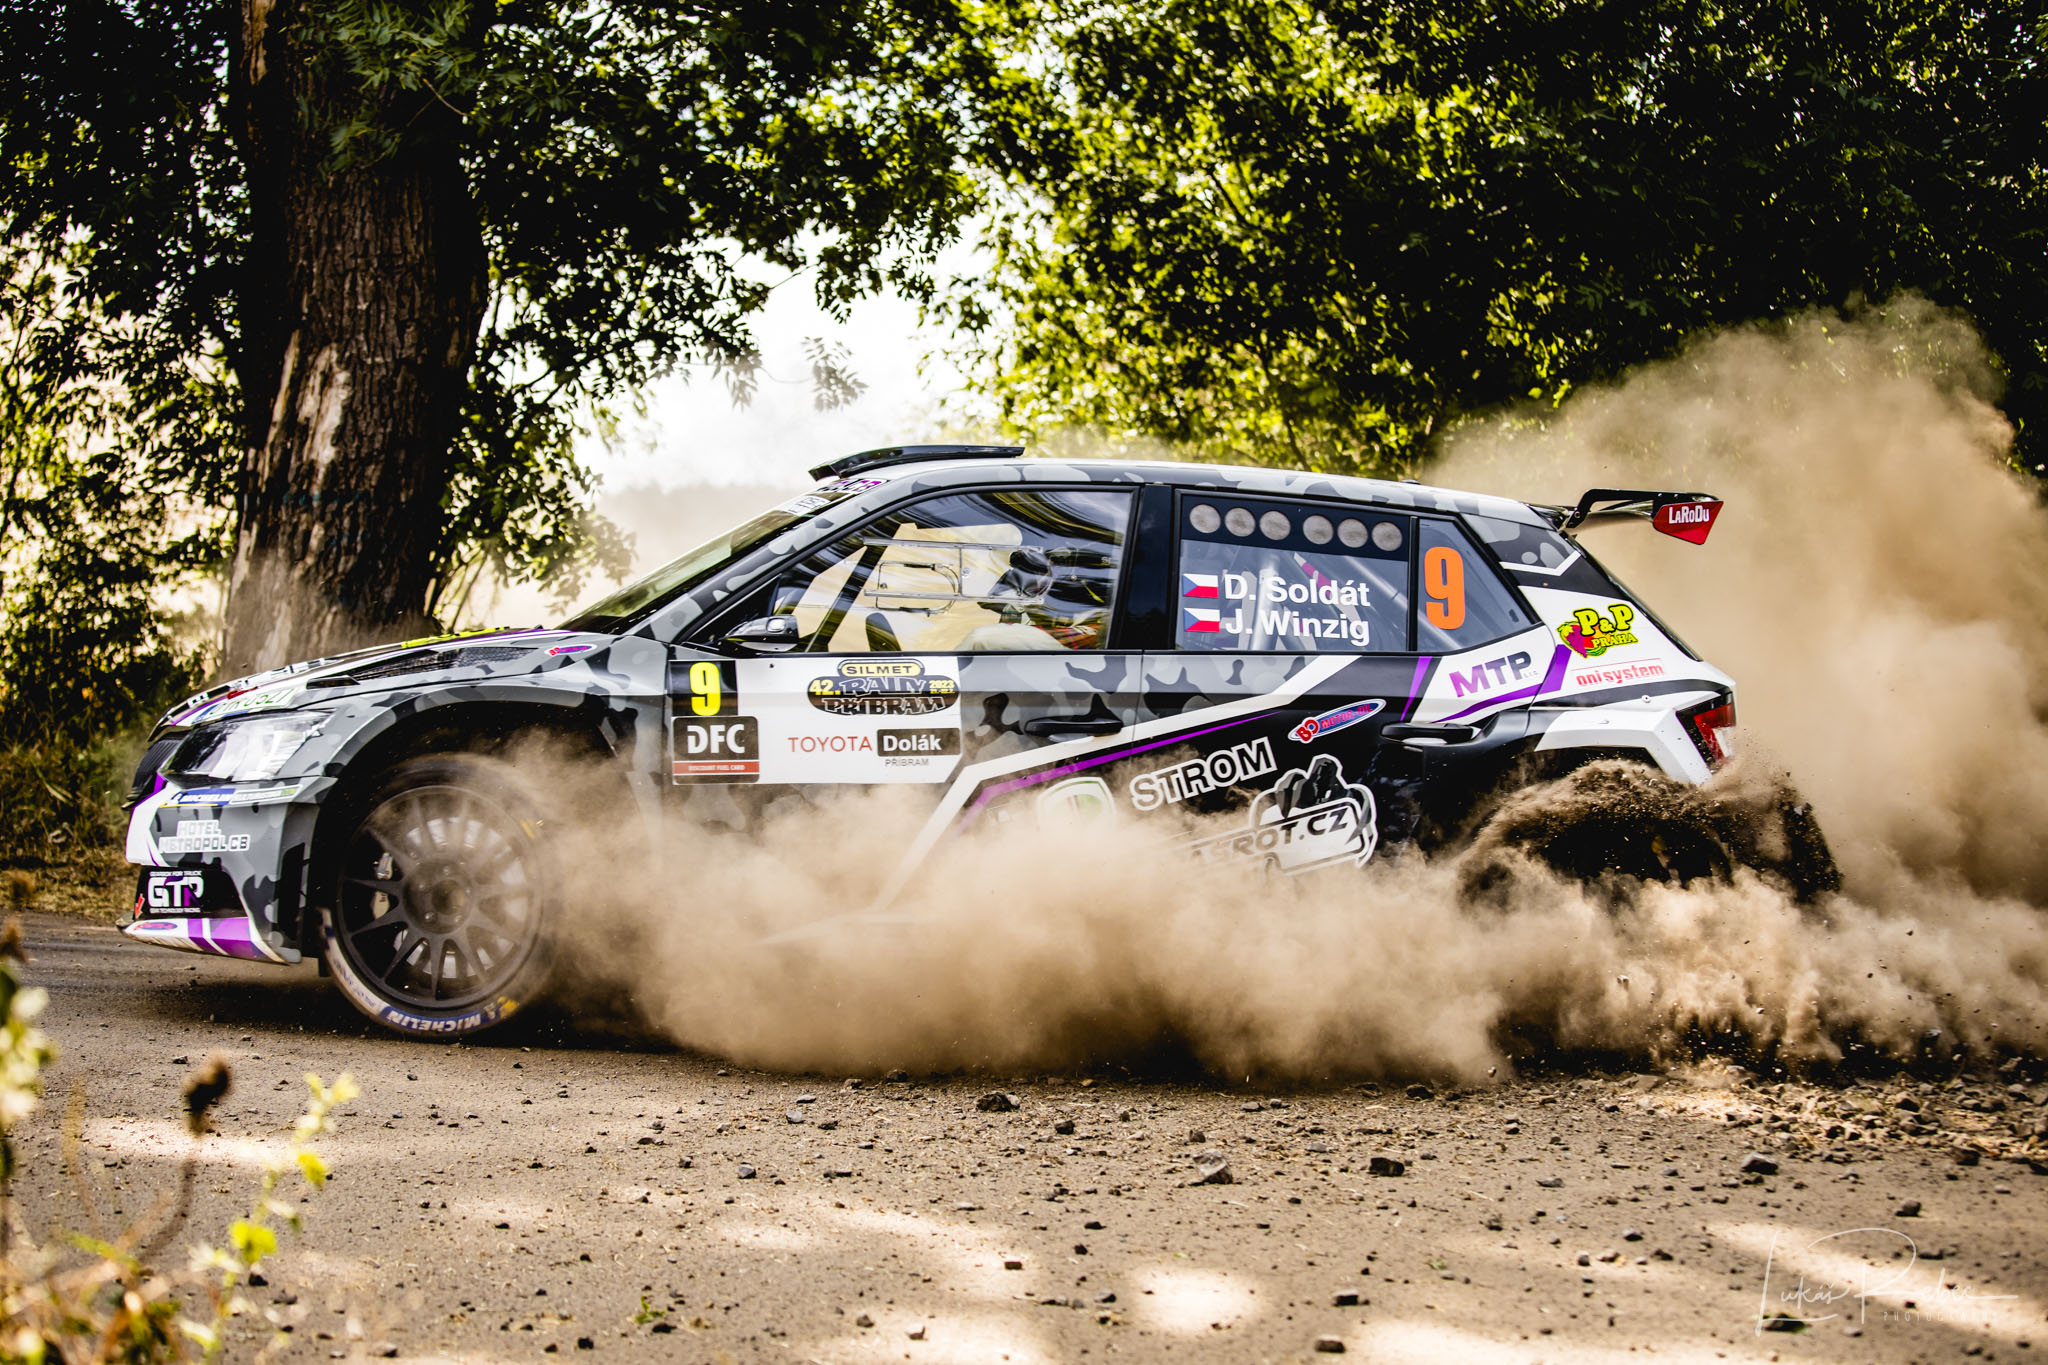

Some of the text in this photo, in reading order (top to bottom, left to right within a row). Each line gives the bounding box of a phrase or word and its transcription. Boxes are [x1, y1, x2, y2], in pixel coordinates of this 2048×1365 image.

[1224, 574, 1371, 607] D. Soldát
[1423, 546, 1466, 630] 9
[1225, 608, 1371, 647] J. Winzig
[1573, 604, 1634, 637] P&P
[1590, 633, 1638, 648] PRAHA
[846, 665, 912, 675] SILMET
[1448, 650, 1532, 698] MTP
[689, 661, 721, 717] 9
[809, 677, 927, 697] 42. RALLY
[1320, 703, 1374, 729] MOTOR-OIL
[687, 723, 746, 754] DFC
[787, 735, 873, 753] TOYOTA
[882, 734, 942, 752] Dolák
[1130, 737, 1277, 810] STROM
[178, 821, 221, 835] HOTEL
[386, 1010, 482, 1032] MICHELIN
